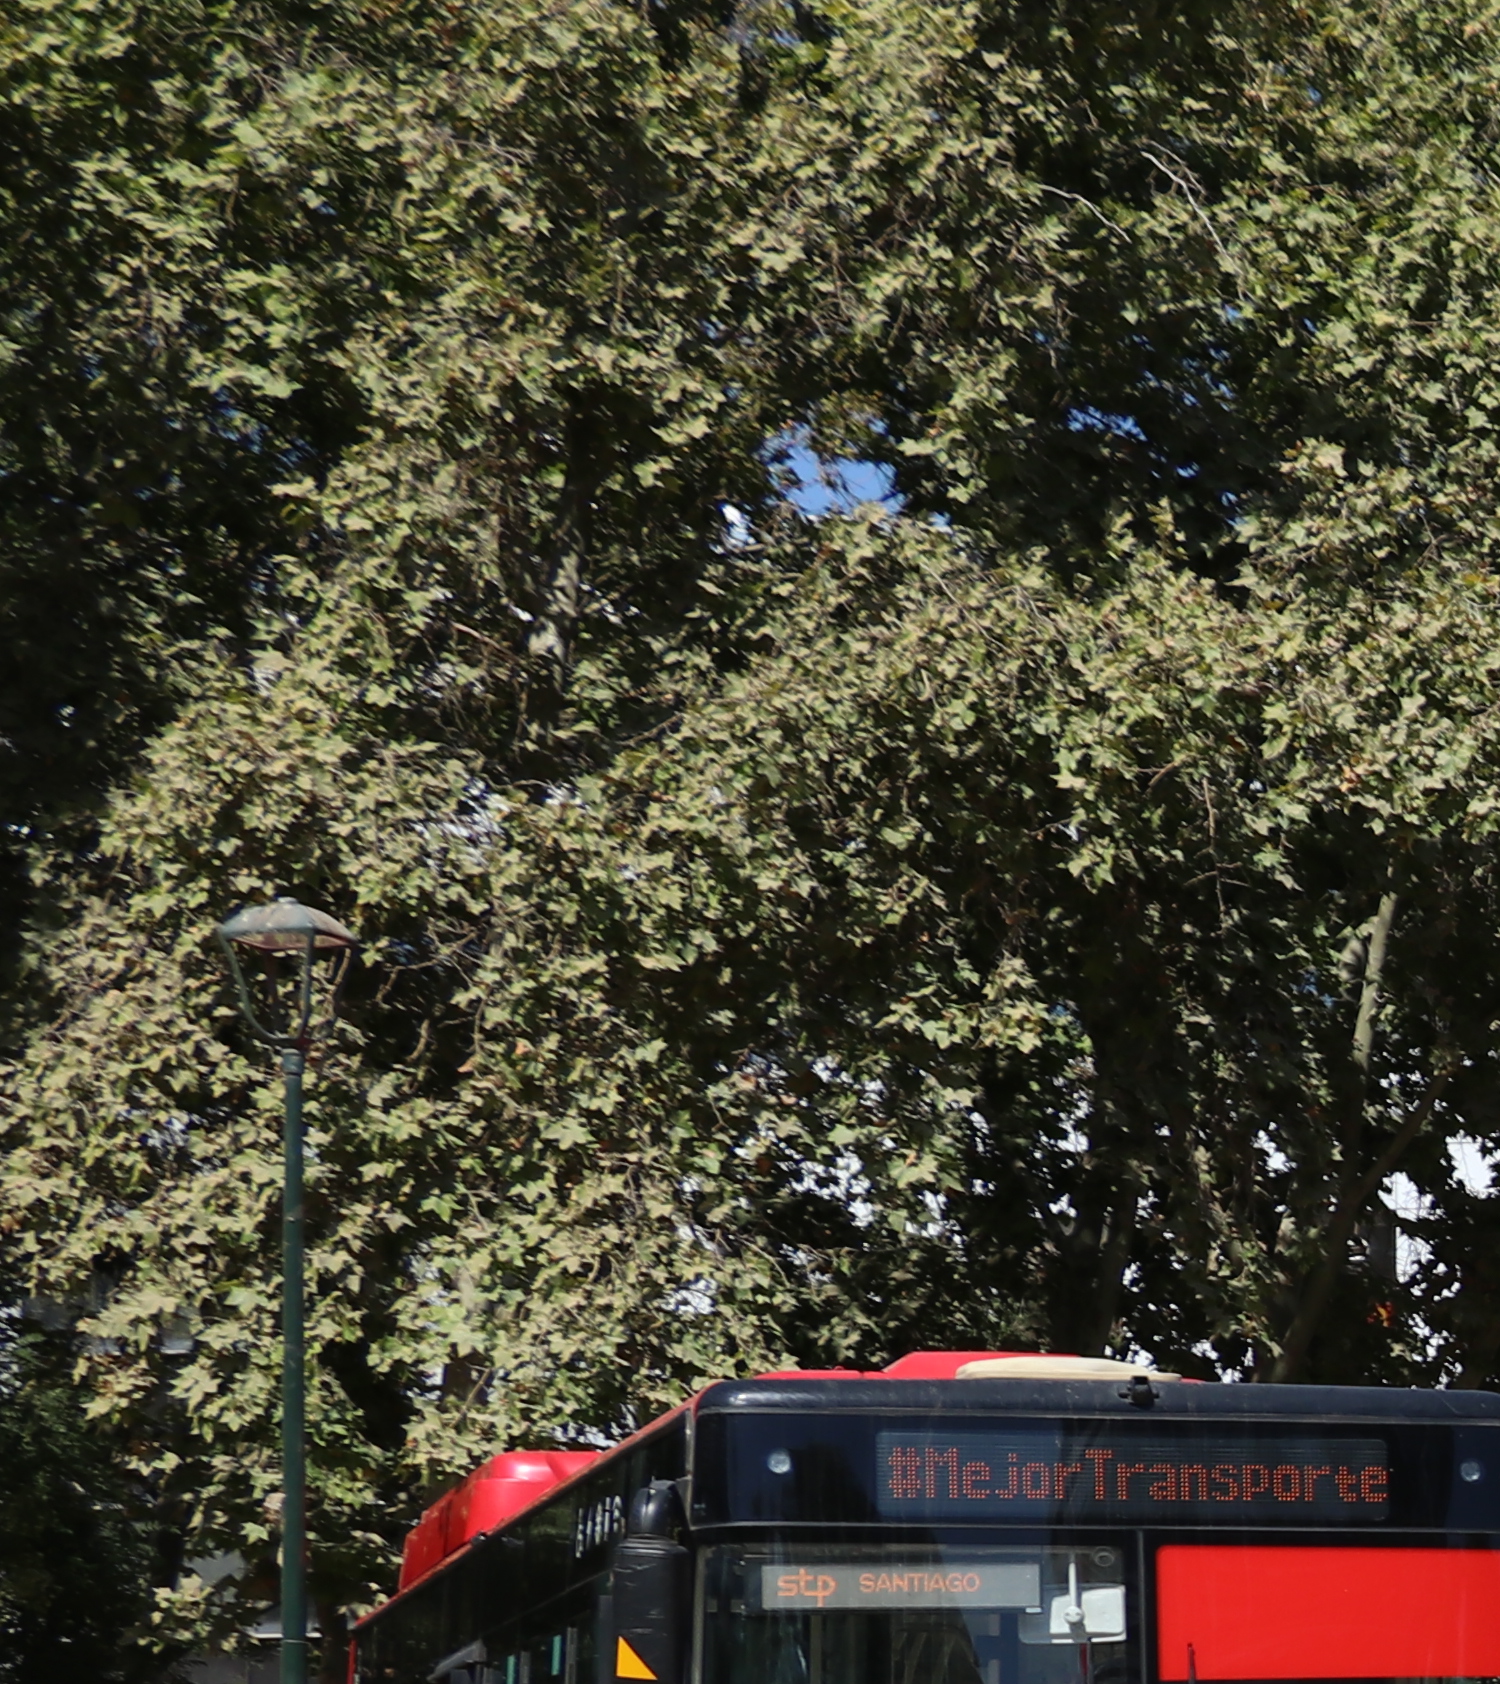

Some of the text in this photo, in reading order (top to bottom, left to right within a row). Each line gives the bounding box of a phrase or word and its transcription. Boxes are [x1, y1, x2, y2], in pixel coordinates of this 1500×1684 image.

[887, 1447, 1389, 1502] #MejorTransporte
[776, 1567, 982, 1607] stp SANTIAGO
